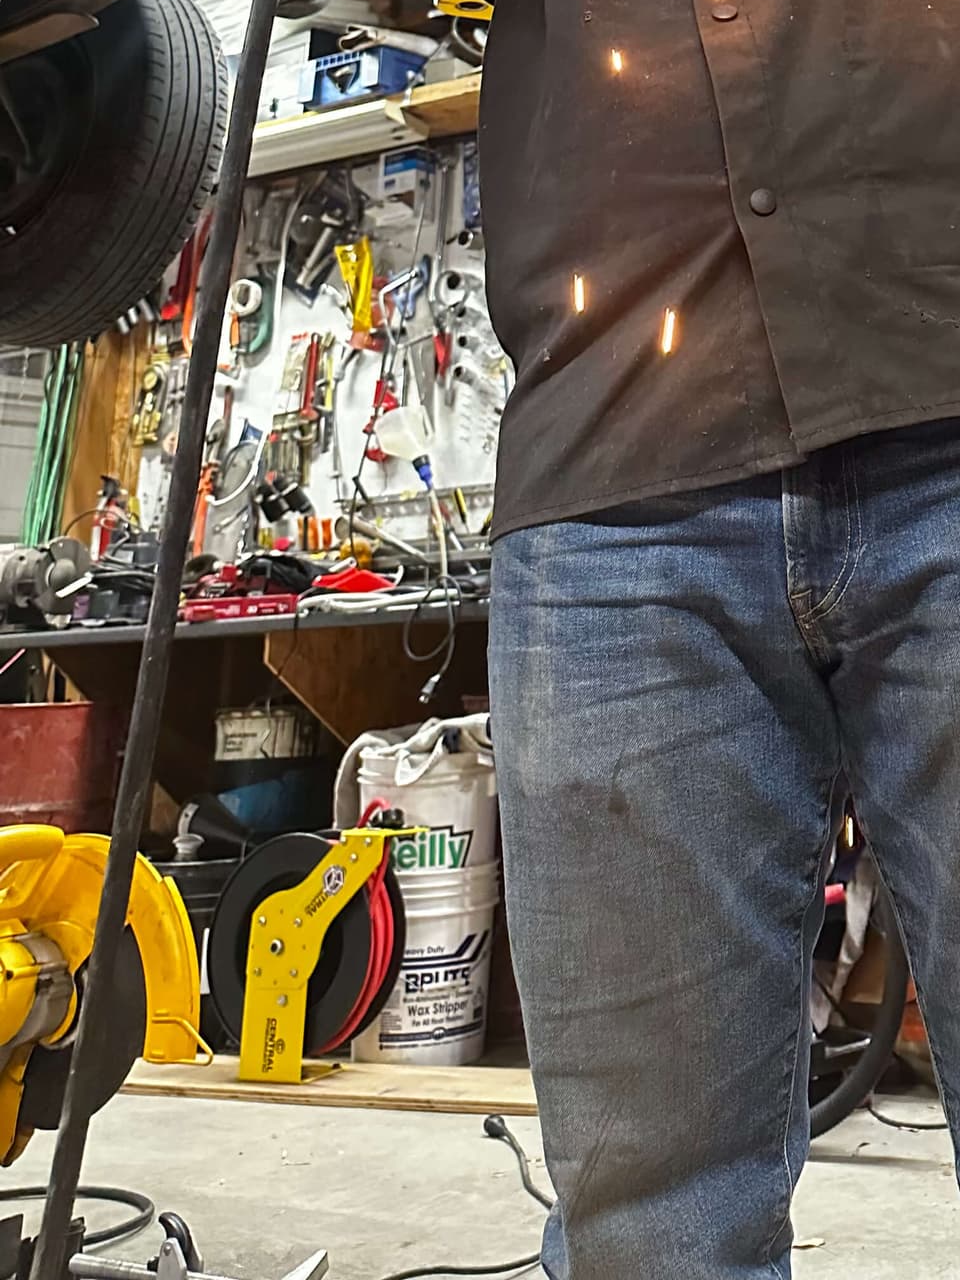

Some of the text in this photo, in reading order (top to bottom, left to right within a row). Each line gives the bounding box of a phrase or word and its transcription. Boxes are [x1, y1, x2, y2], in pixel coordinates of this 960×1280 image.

[427, 946, 445, 954] Duty
[407, 1000, 468, 1017] Wax Stripper
[267, 1018, 277, 1073] CENTRAL
